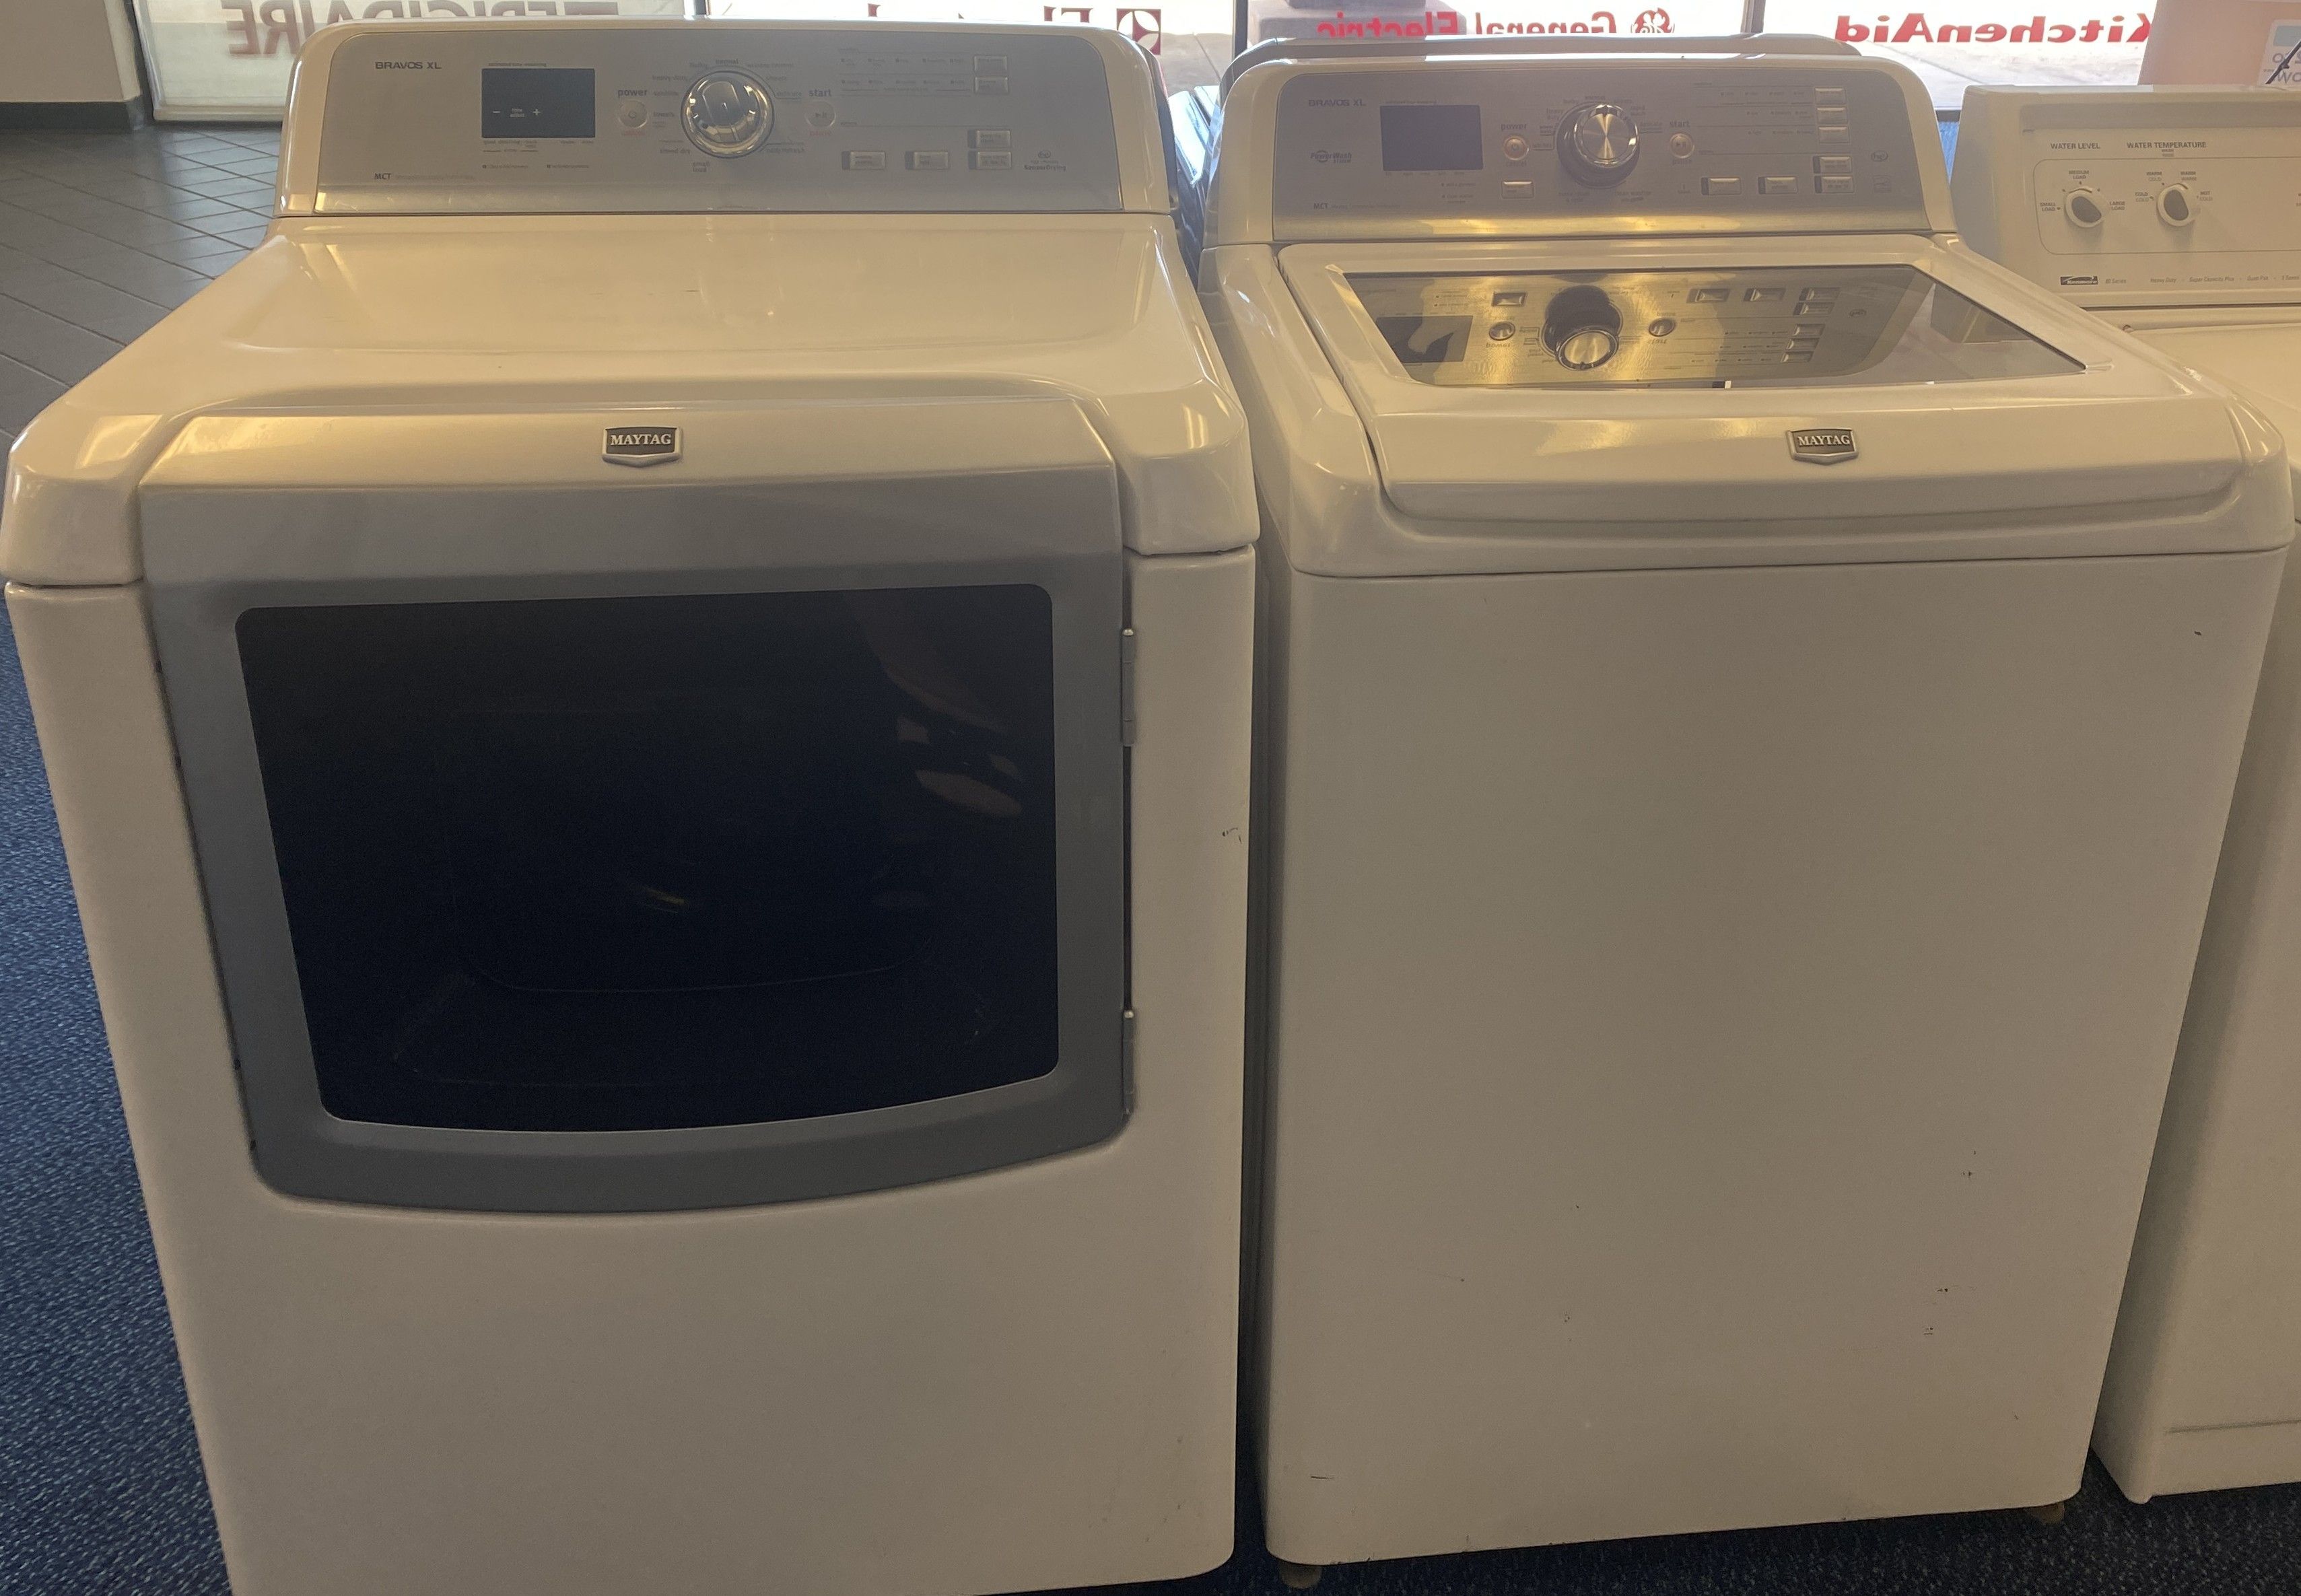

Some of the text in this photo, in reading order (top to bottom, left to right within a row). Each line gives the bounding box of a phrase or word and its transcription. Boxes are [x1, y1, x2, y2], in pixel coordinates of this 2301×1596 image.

[375, 61, 442, 69] BRAVOS XL
[617, 89, 648, 98] power
[808, 89, 831, 97] start
[1308, 99, 1350, 107] BRAVOS
[1501, 123, 1527, 131] power
[1670, 120, 1690, 128] start
[611, 433, 671, 446] MAYTAG
[1797, 434, 1850, 446] MAYTAG
